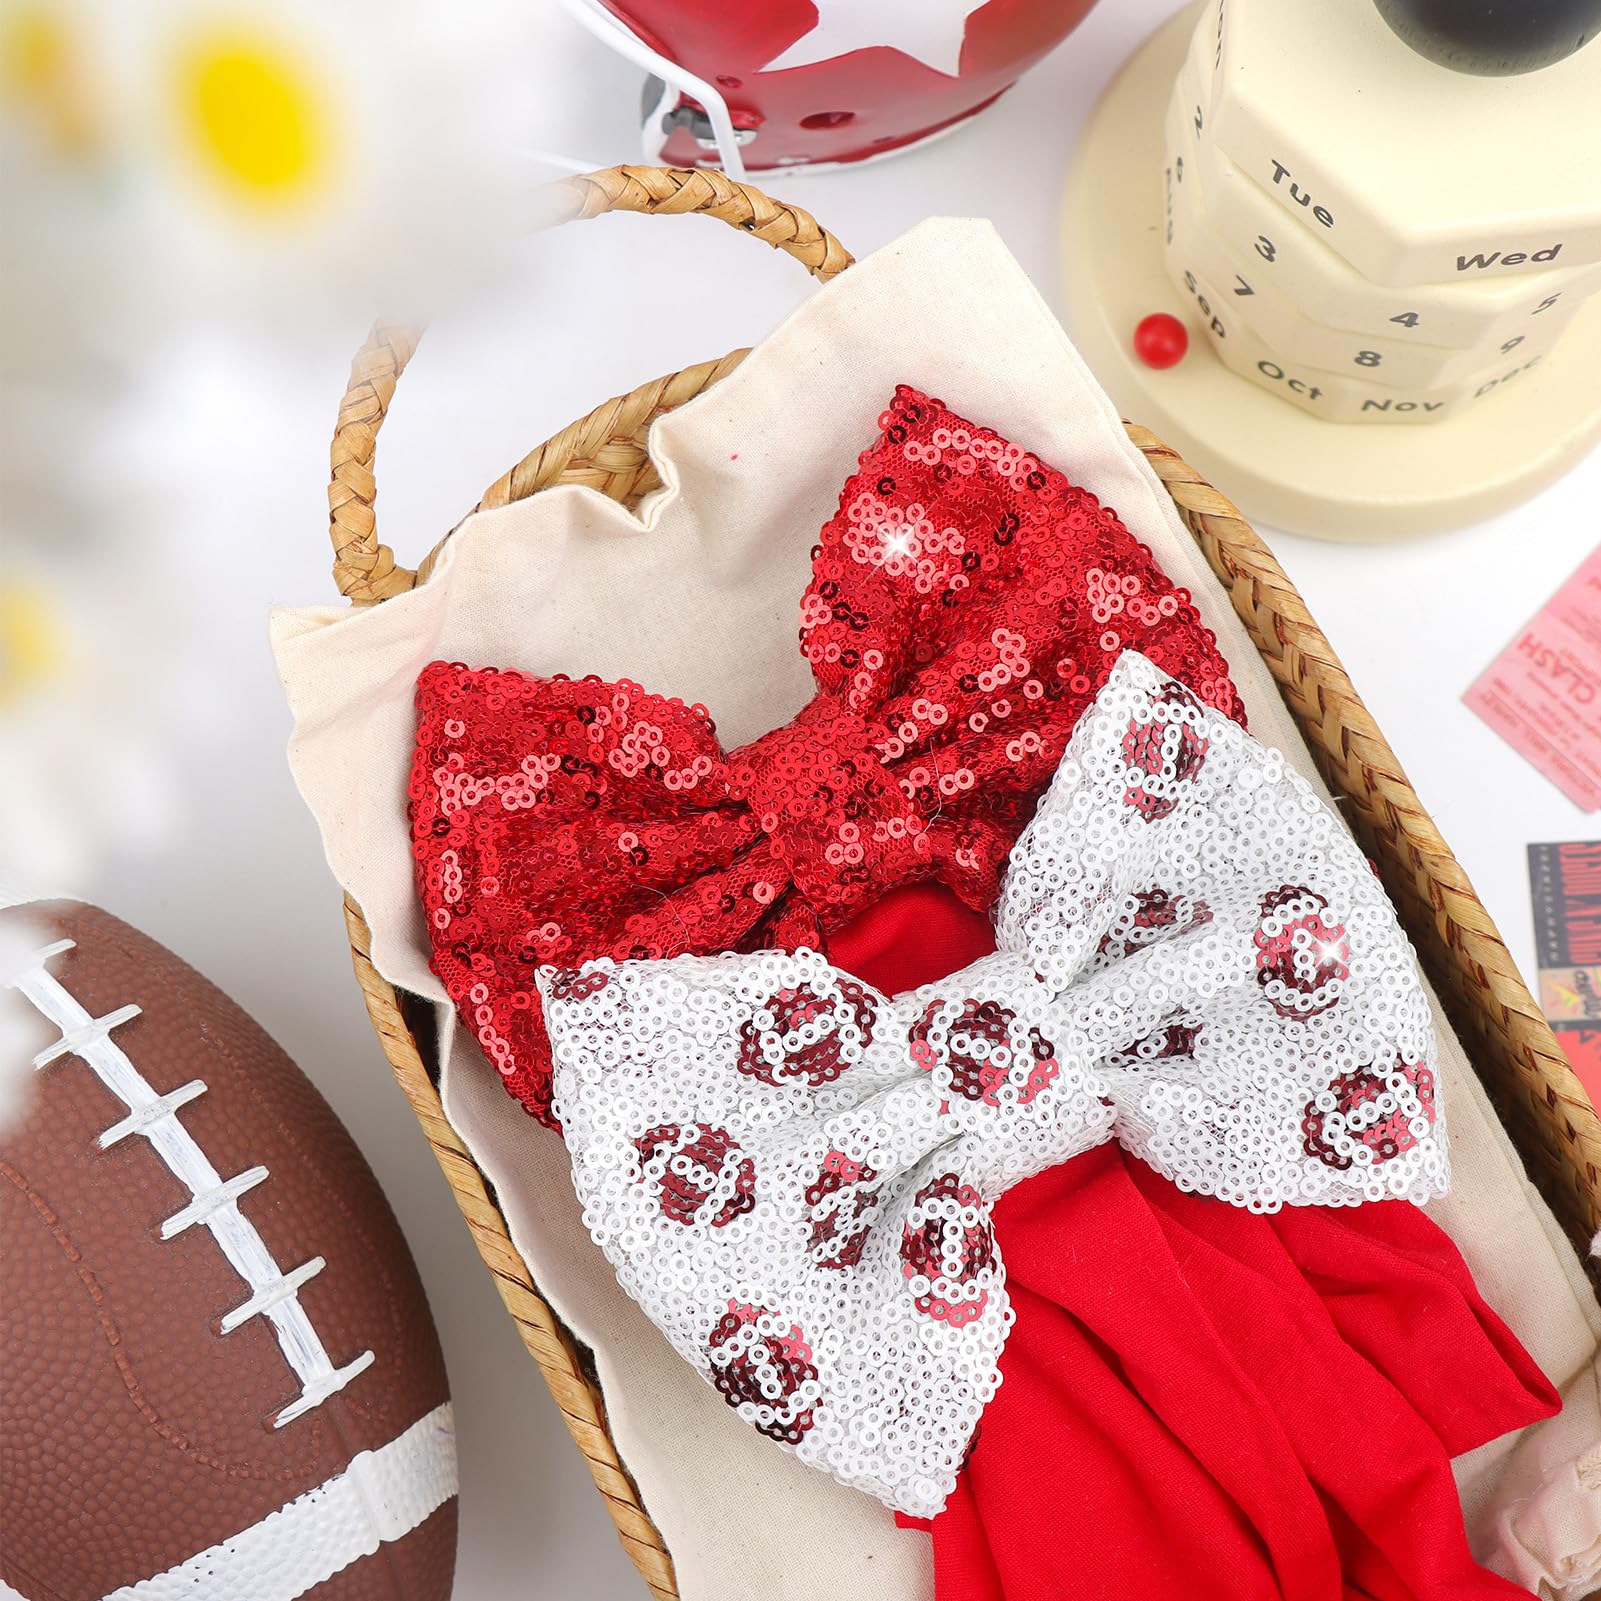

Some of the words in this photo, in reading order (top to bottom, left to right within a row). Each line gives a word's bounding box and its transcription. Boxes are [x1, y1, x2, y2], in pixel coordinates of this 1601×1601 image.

[1194, 105, 1203, 139] 2
[1271, 159, 1334, 229] Tue
[1254, 235, 1276, 263] 3
[1456, 243, 1563, 271] Wed
[1233, 275, 1255, 297] 7
[1184, 270, 1225, 338] Sep
[1531, 292, 1562, 315] 5
[1389, 312, 1420, 328] 4
[1353, 351, 1382, 367] 8
[1500, 336, 1526, 355] 9
[1257, 360, 1323, 400] Oct
[1361, 399, 1445, 412] Nov
[1518, 632, 1596, 705] CLASH
